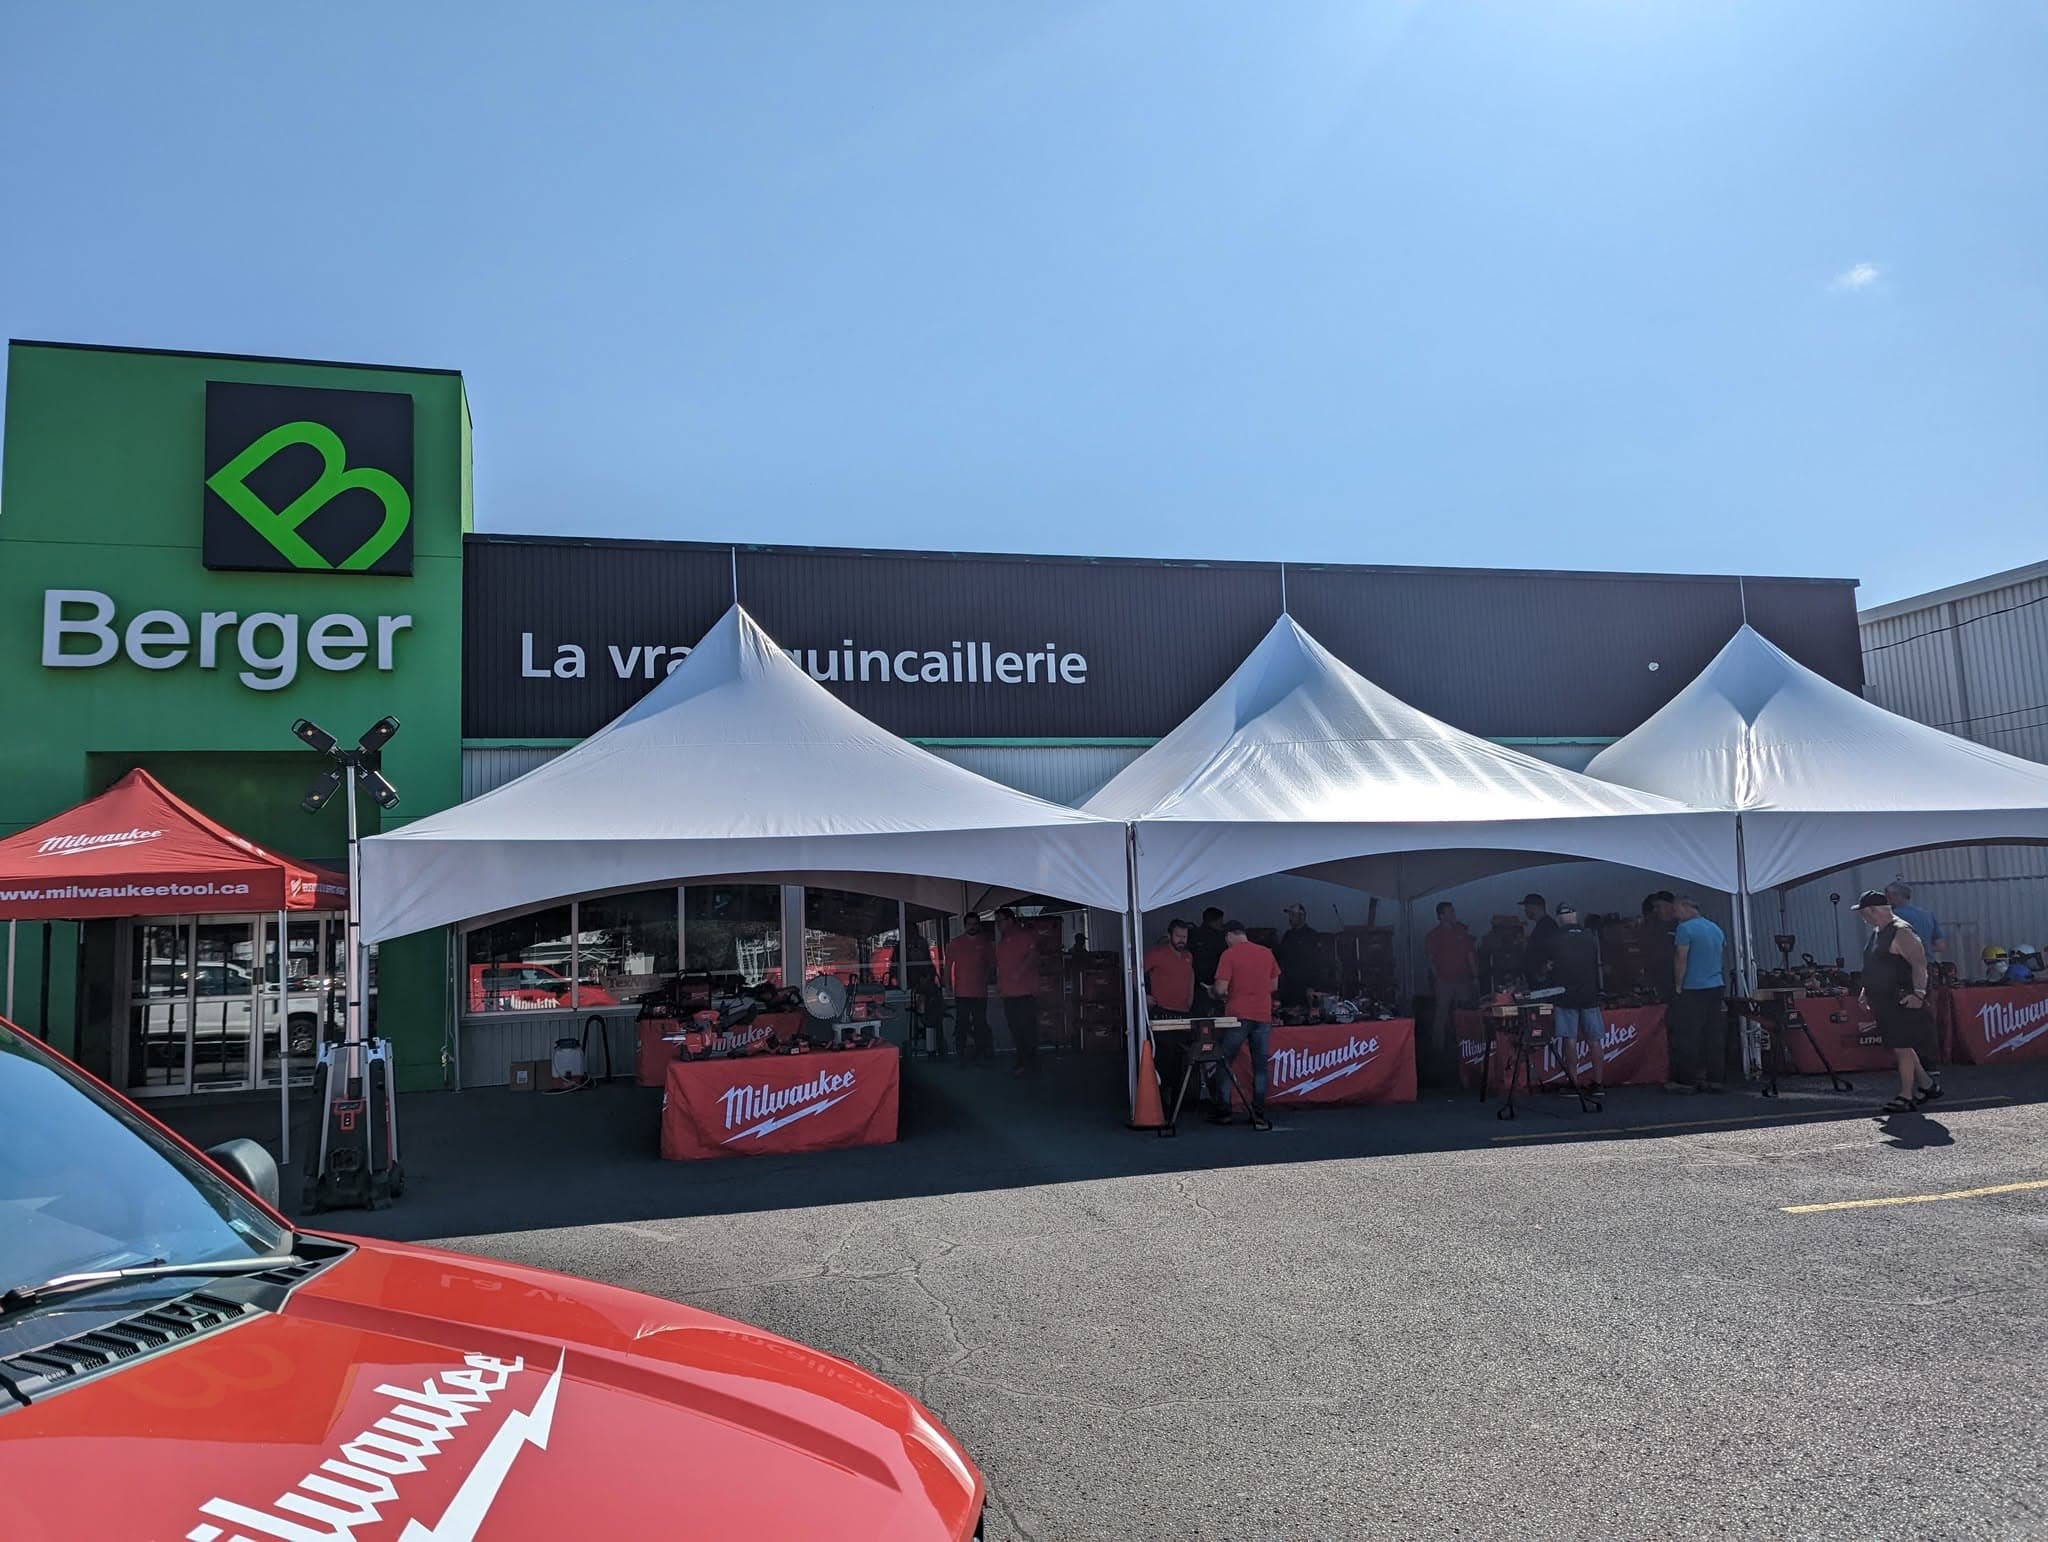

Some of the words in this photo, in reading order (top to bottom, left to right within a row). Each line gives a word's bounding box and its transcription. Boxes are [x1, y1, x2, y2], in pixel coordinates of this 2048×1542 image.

[206, 421, 411, 569] B
[41, 589, 413, 691] Berger
[521, 632, 586, 679] La
[608, 645, 693, 679] vra
[37, 828, 162, 853] Milwaukee
[1267, 1035, 1380, 1088] Milwaukee
[715, 1069, 856, 1130] Milwaukee
